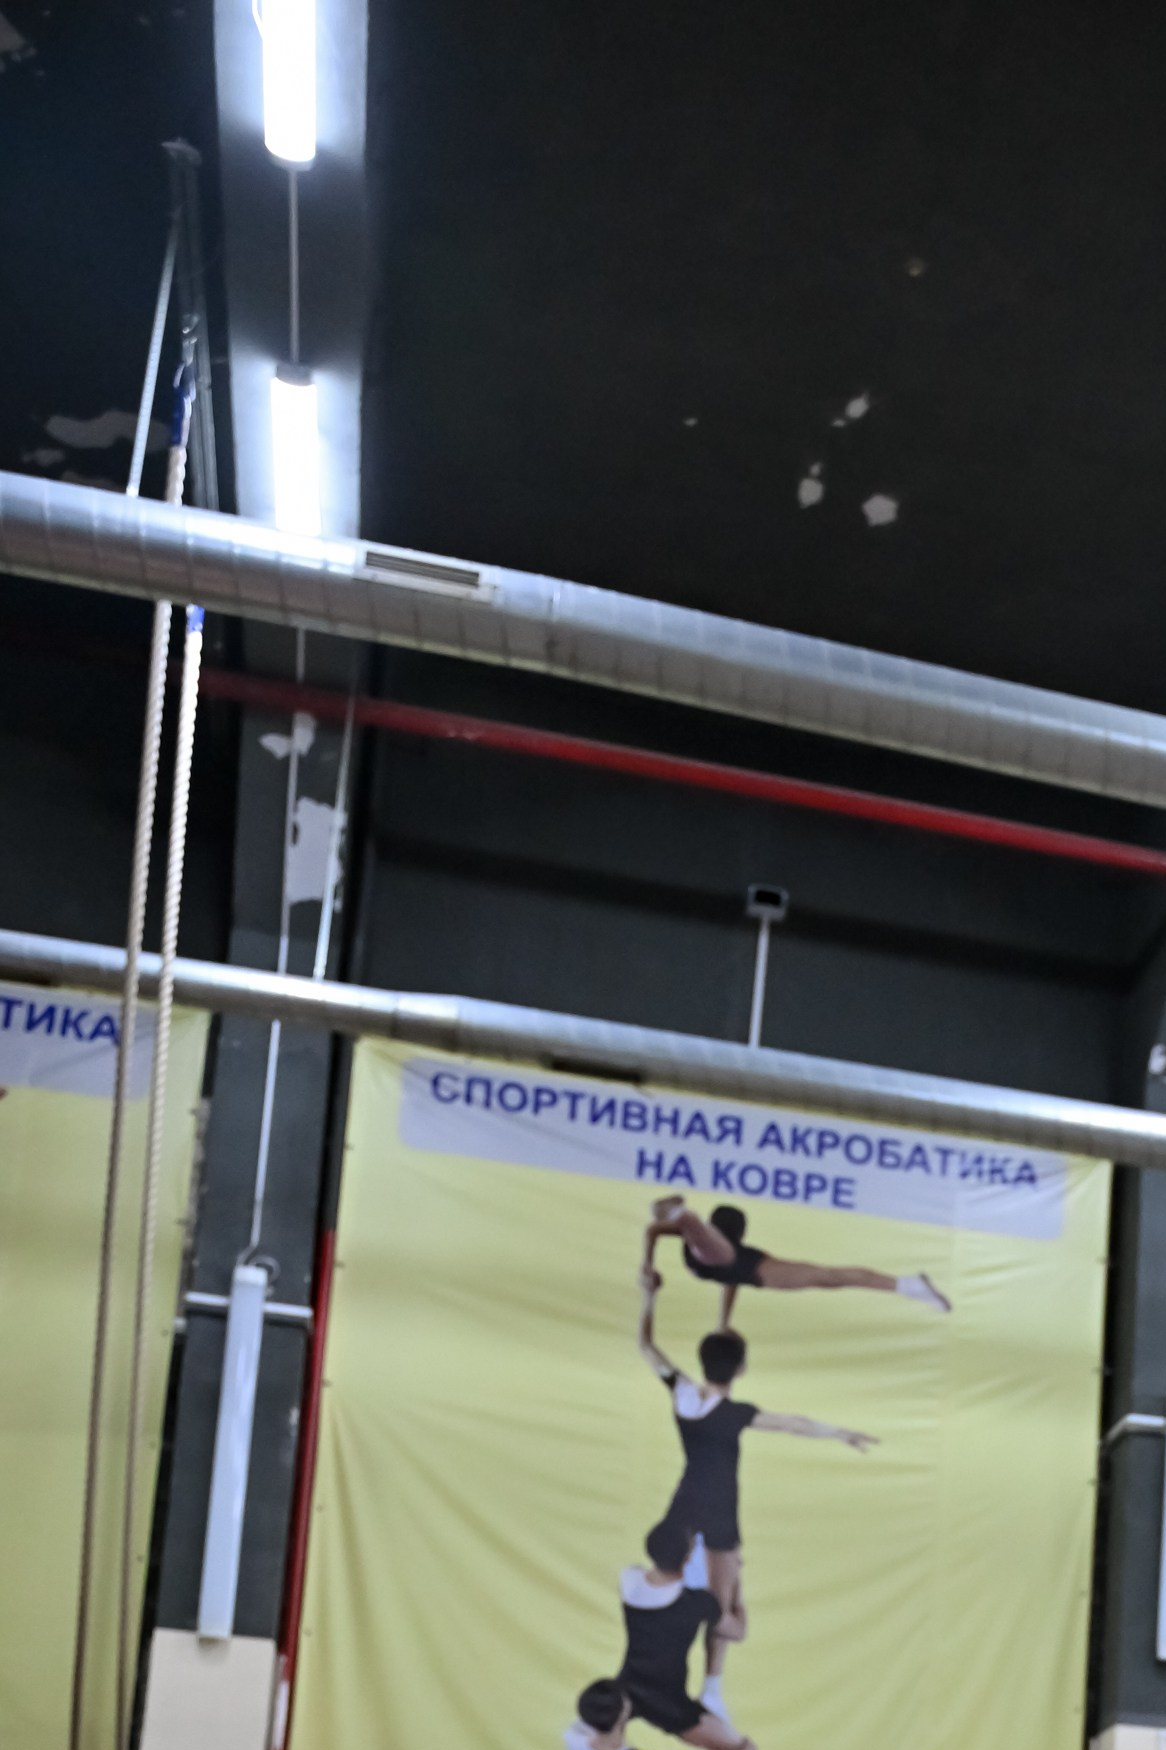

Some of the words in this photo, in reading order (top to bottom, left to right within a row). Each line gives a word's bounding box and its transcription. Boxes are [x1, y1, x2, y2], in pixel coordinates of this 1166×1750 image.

[431, 1071, 744, 1147] СПОРТИВНАЯ
[758, 1121, 1038, 1186] АКРОБАТИКА
[636, 1147, 697, 1187] НА
[711, 1159, 855, 1210] КОВРЕ
